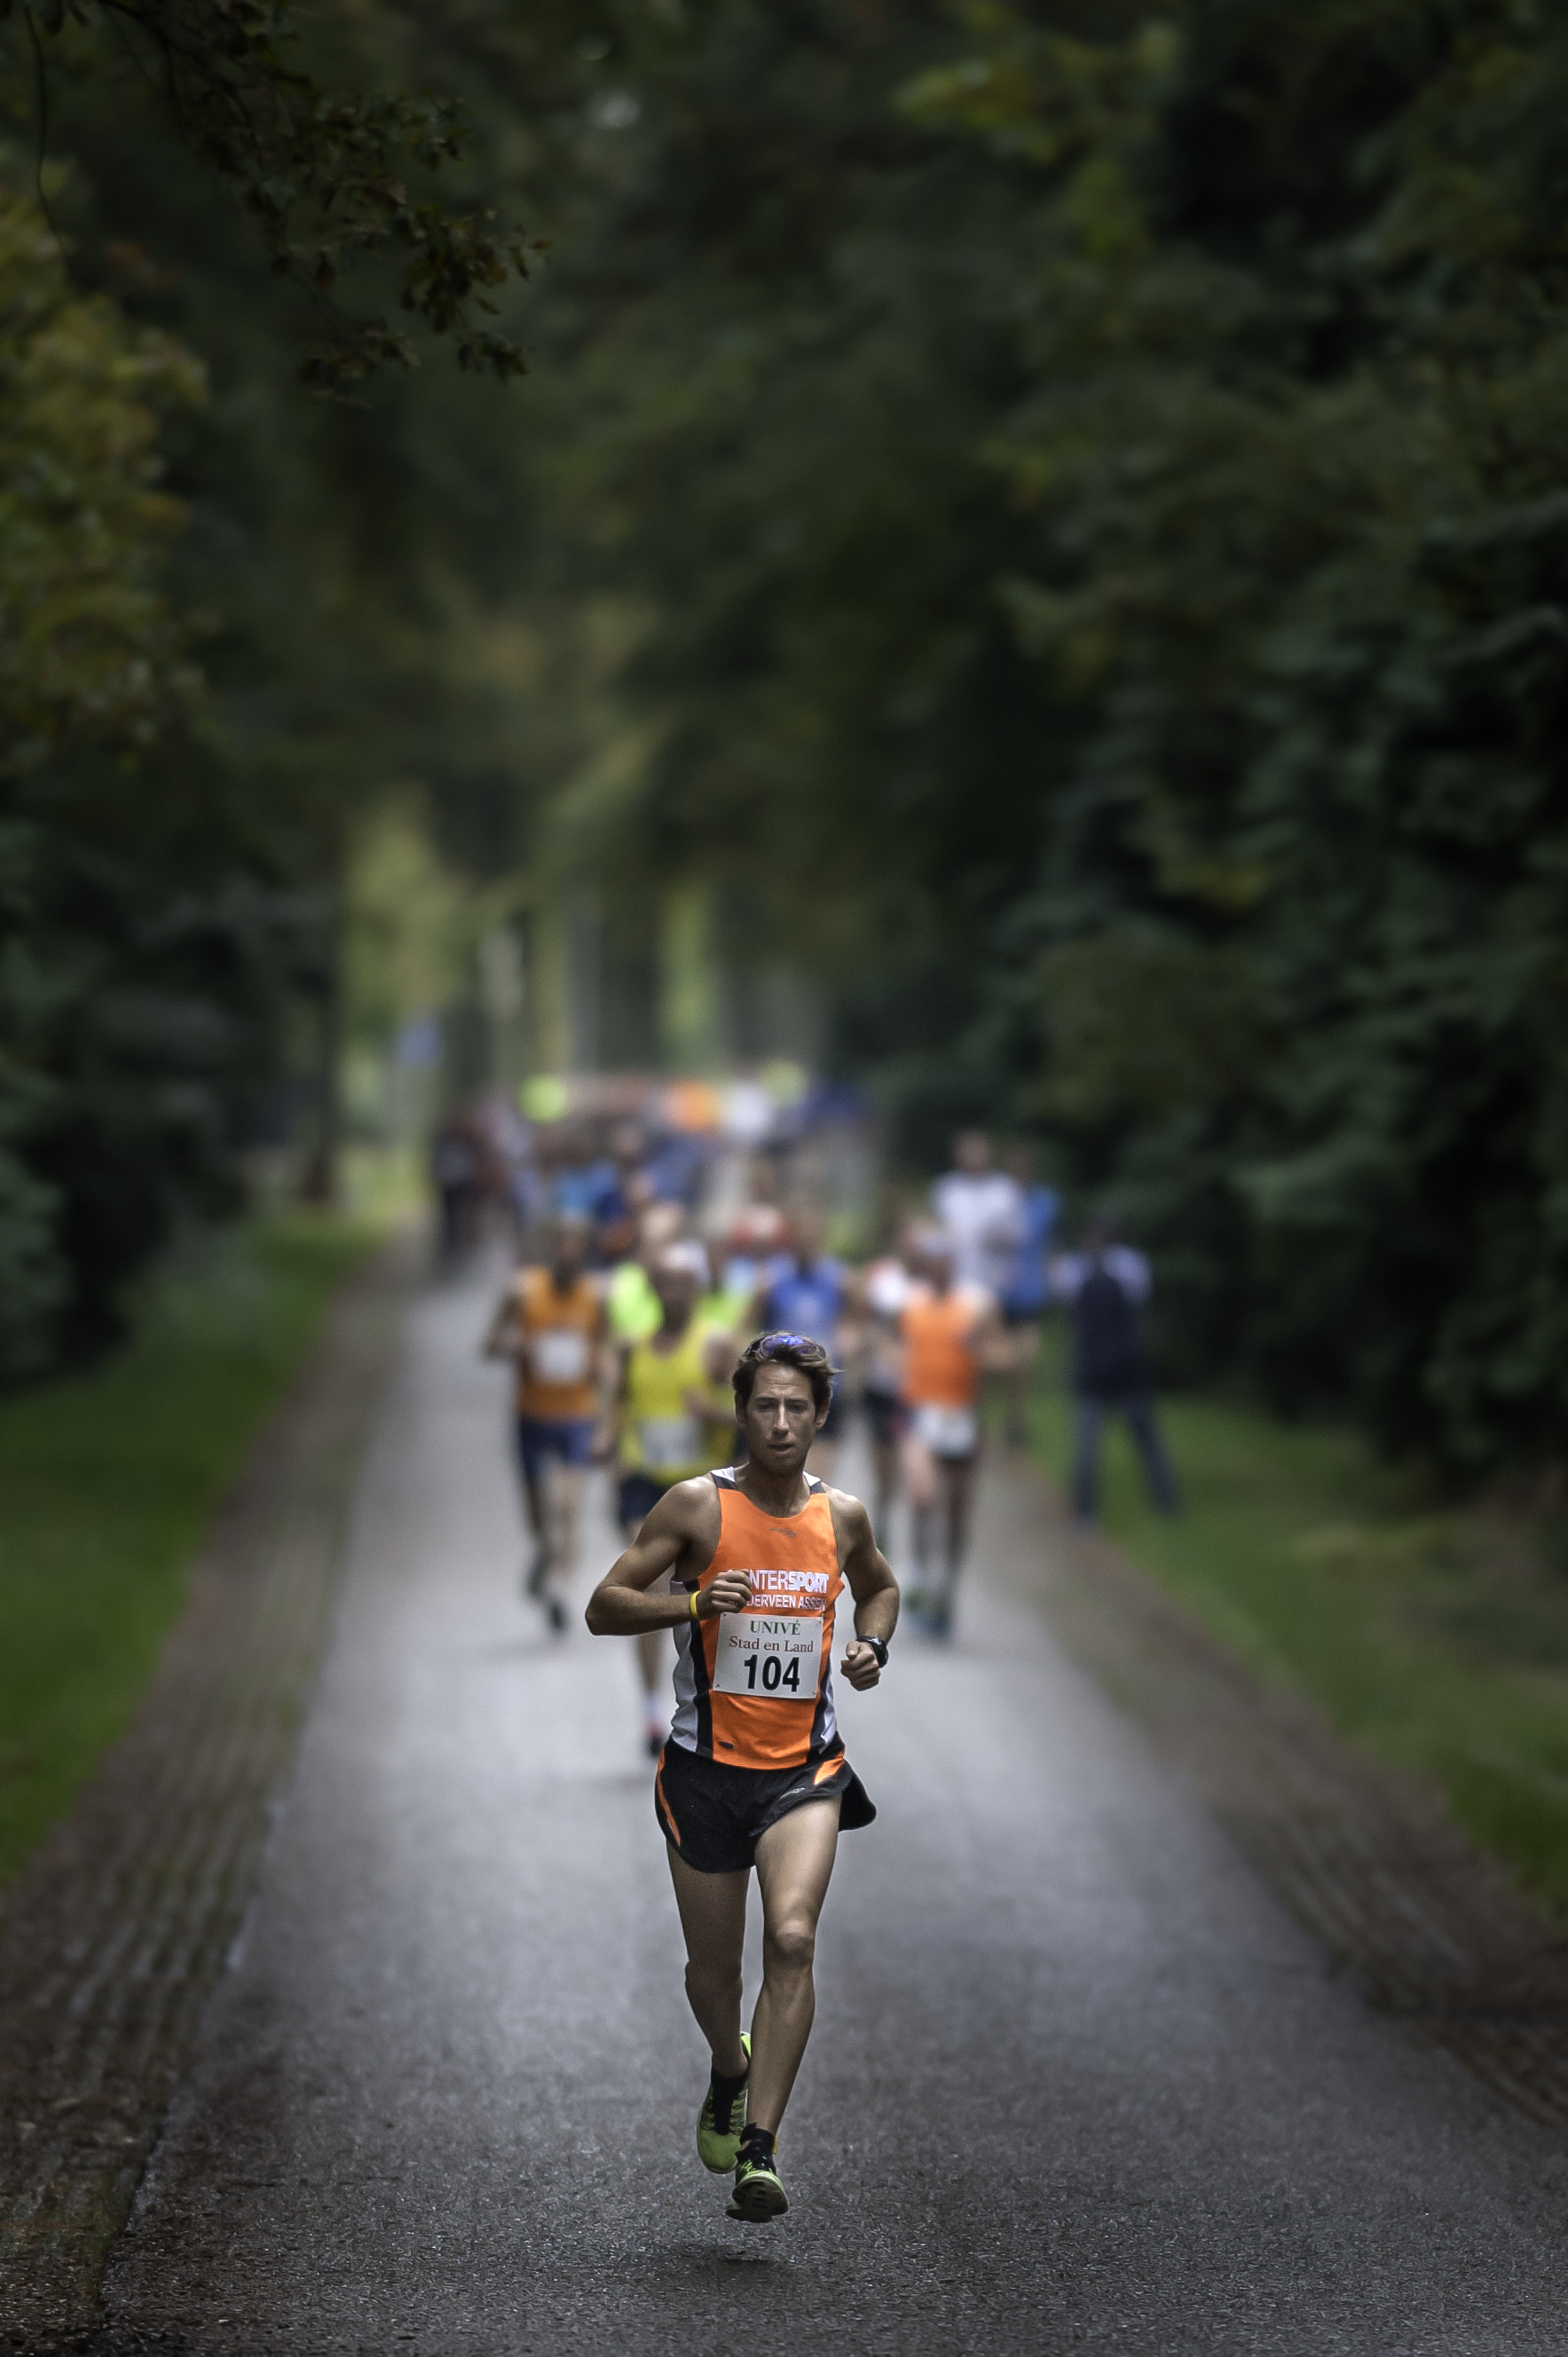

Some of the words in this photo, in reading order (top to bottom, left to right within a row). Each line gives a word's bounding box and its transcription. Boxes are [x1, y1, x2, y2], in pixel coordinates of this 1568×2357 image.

[750, 1569, 829, 1594] NTERSPORT
[747, 1595, 796, 1608] DERVEEN
[750, 1620, 800, 1636] UNIVÉ
[729, 1636, 760, 1650] Stad
[763, 1641, 780, 1651] en
[784, 1640, 814, 1652] Land
[744, 1654, 800, 1692] 104
